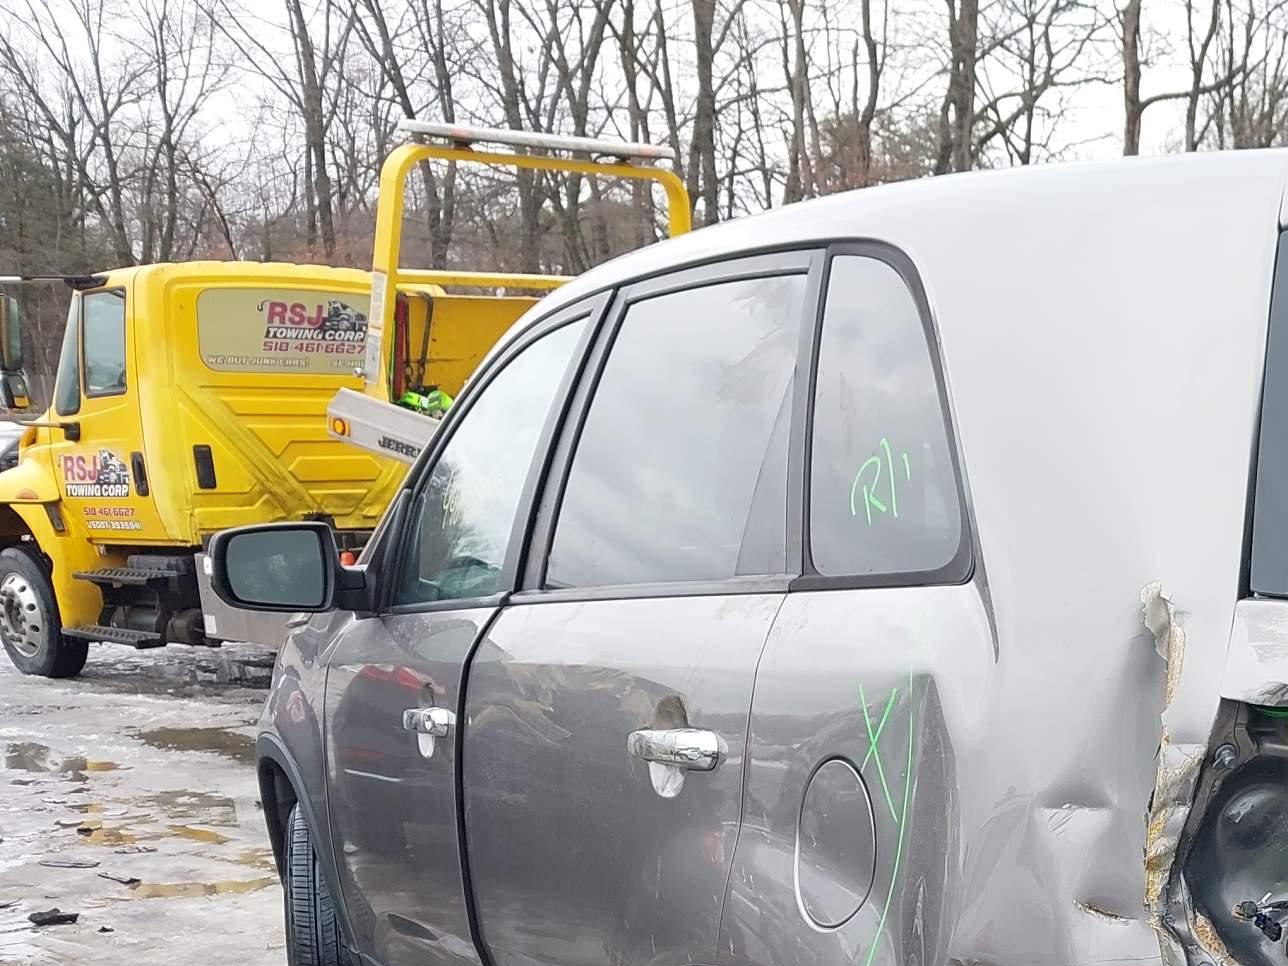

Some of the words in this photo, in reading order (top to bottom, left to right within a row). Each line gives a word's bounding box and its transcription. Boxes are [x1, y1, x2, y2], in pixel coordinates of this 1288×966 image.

[267, 301, 324, 327] RSJ
[268, 327, 323, 340] TOWING
[263, 341, 289, 352] 518
[63, 455, 97, 482] RSJ
[66, 484, 100, 497] TOWING
